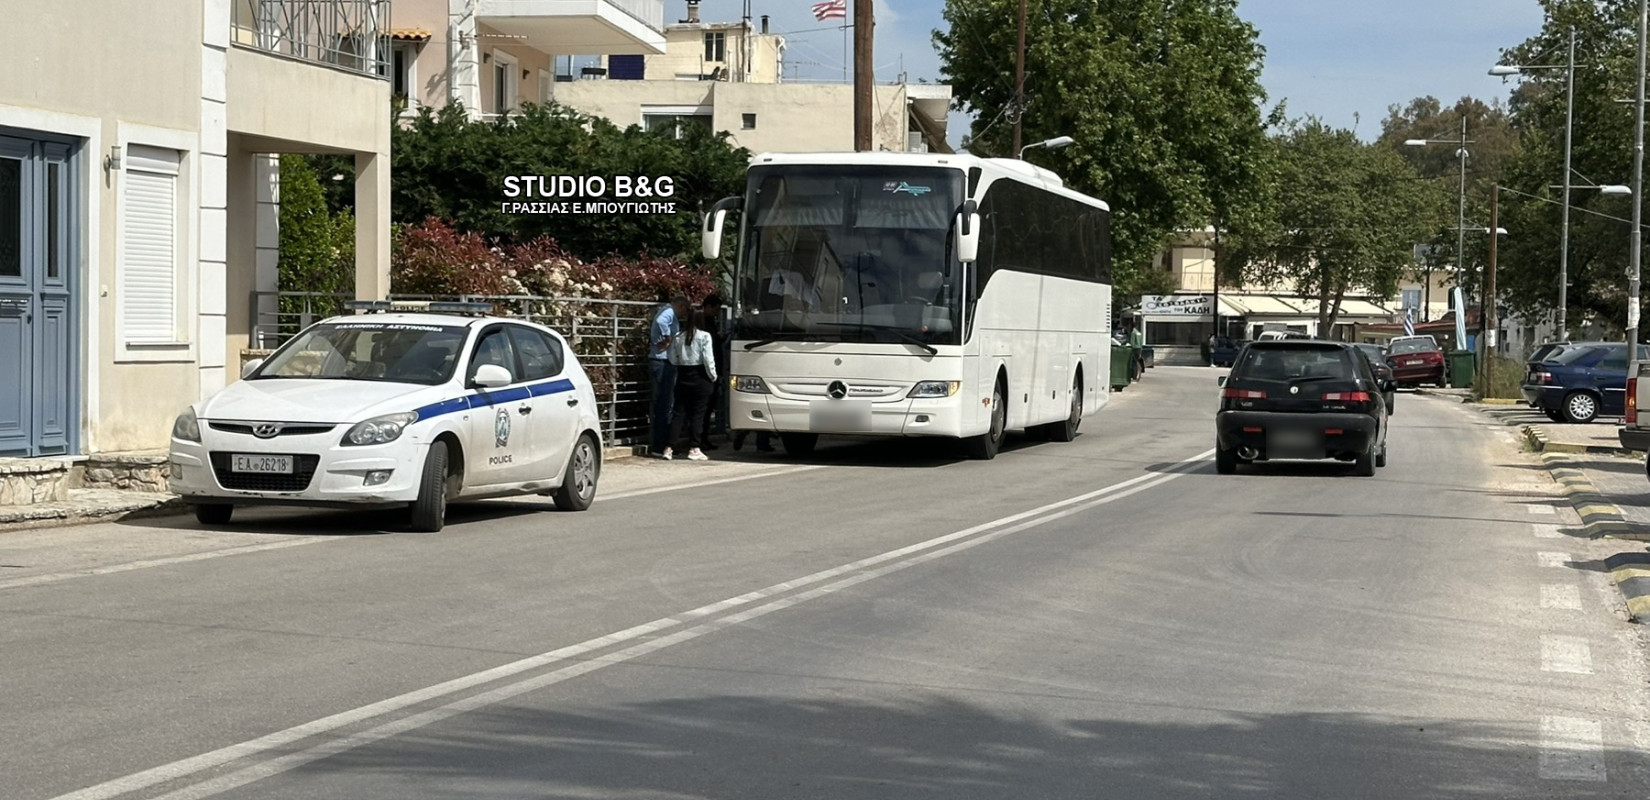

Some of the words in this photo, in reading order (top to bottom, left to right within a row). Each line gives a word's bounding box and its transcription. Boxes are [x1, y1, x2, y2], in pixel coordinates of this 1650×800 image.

[1184, 306, 1210, 314] ΚΑΔΗ
[260, 457, 287, 472] 26218
[489, 454, 513, 465] POLICE
